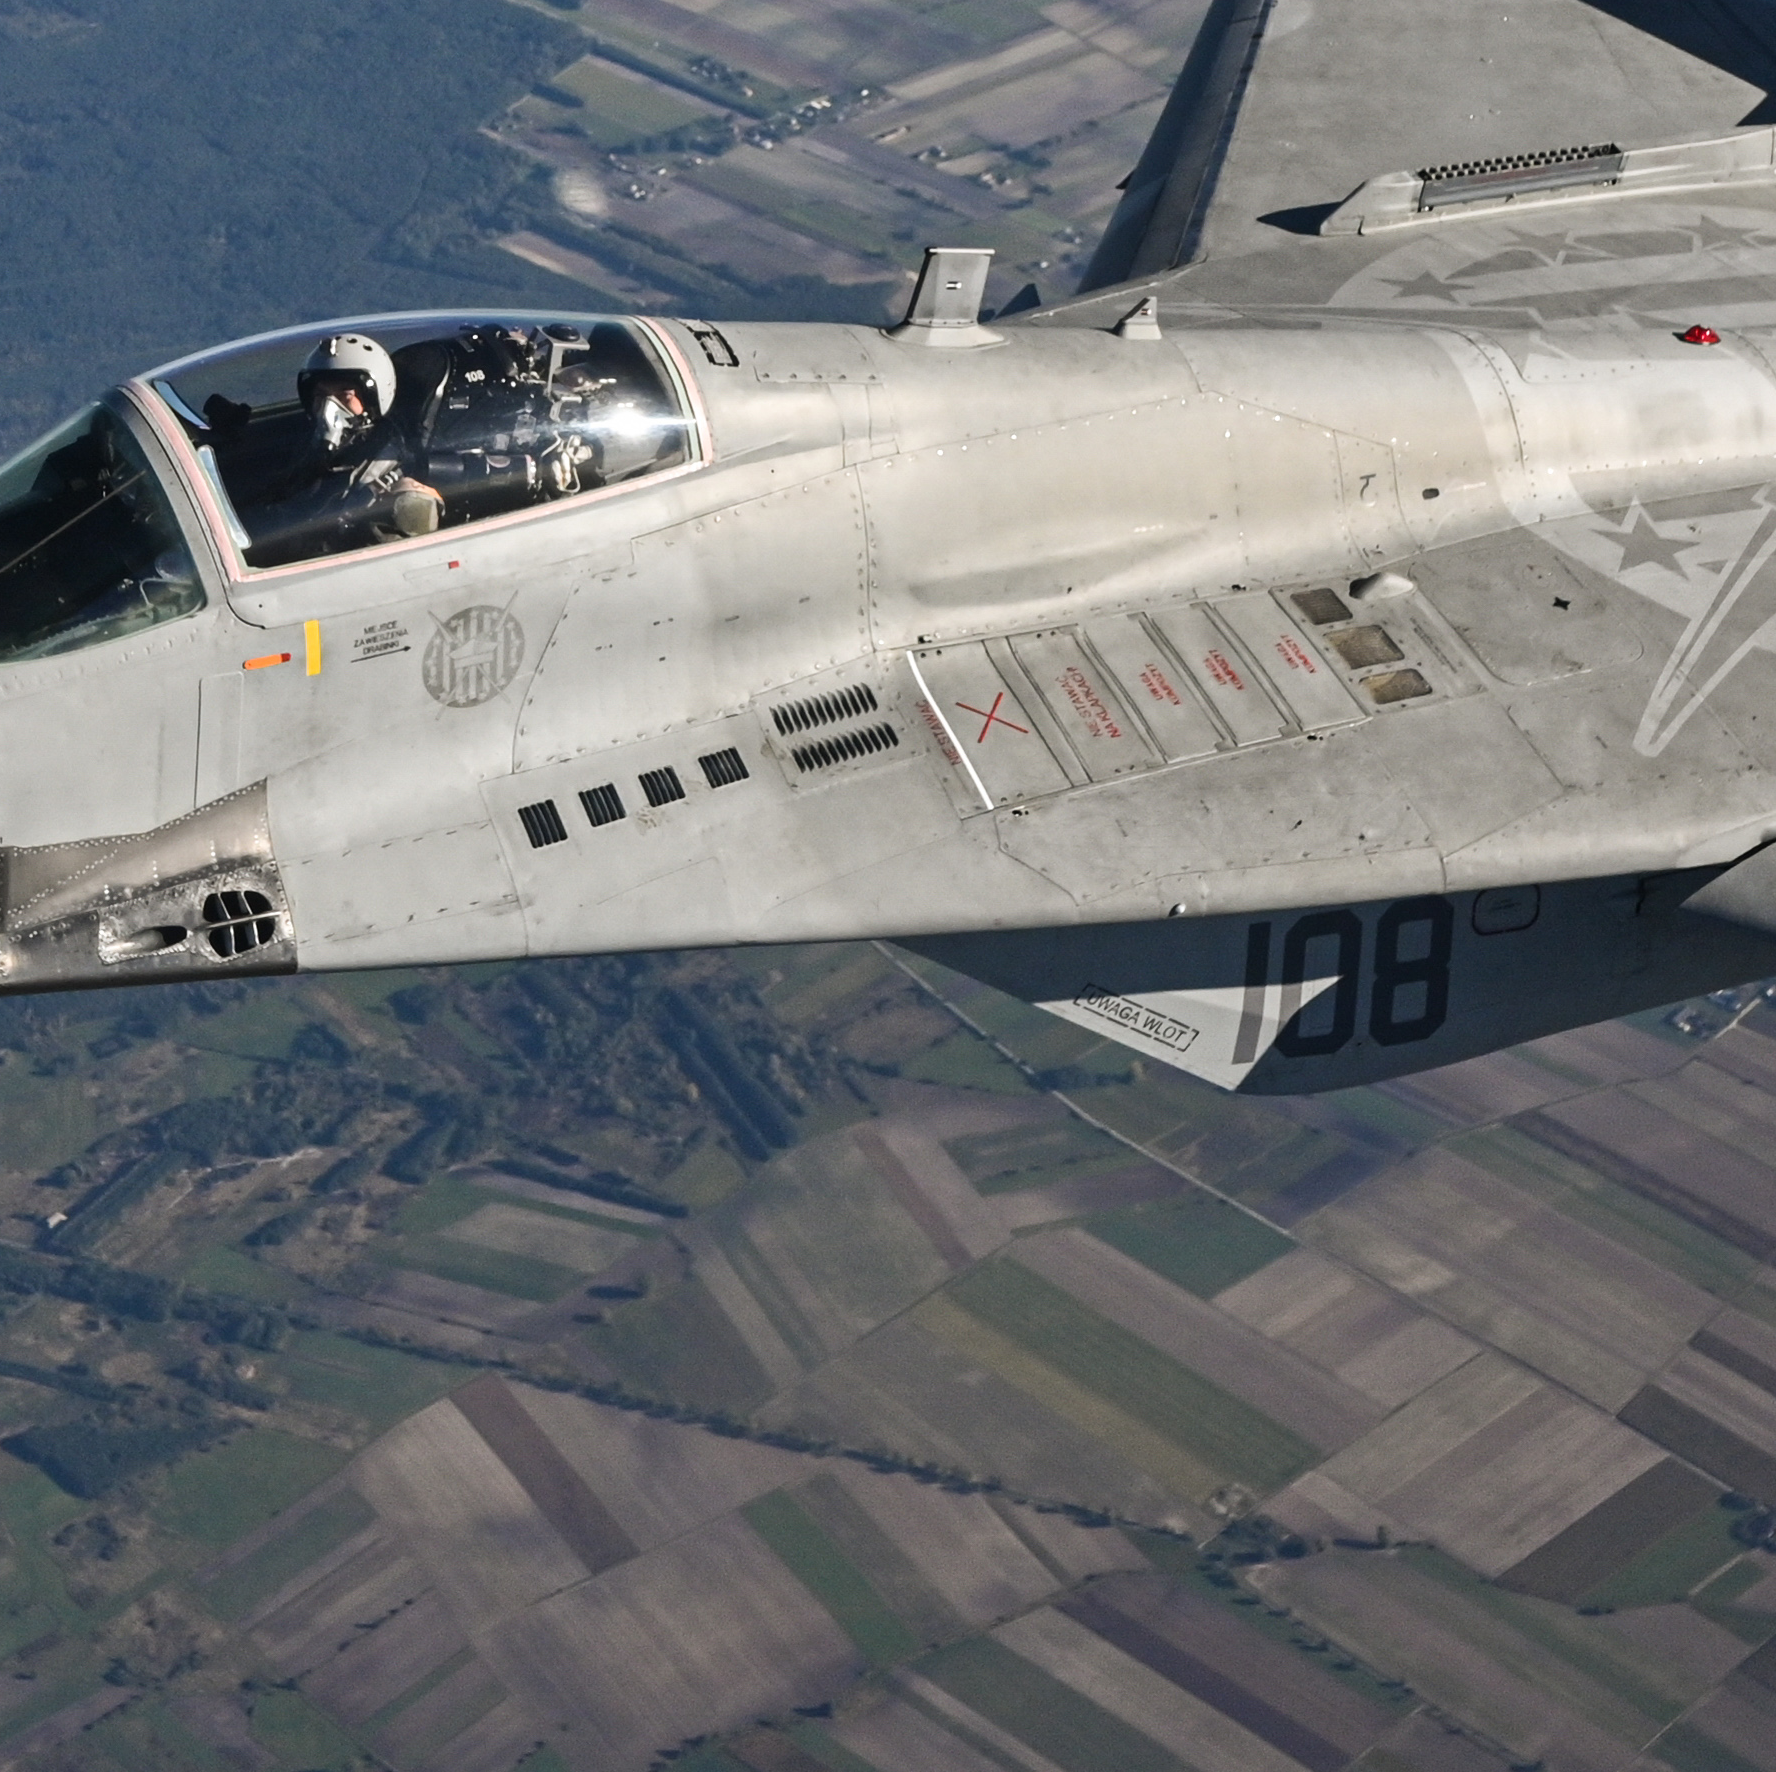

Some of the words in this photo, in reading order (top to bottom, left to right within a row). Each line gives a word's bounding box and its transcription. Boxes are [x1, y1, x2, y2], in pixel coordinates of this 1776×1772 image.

[464, 369, 485, 383] 108
[1231, 894, 1454, 1065] 108
[1086, 991, 1141, 1025] UWAGA
[1142, 1015, 1187, 1043] WLOT
